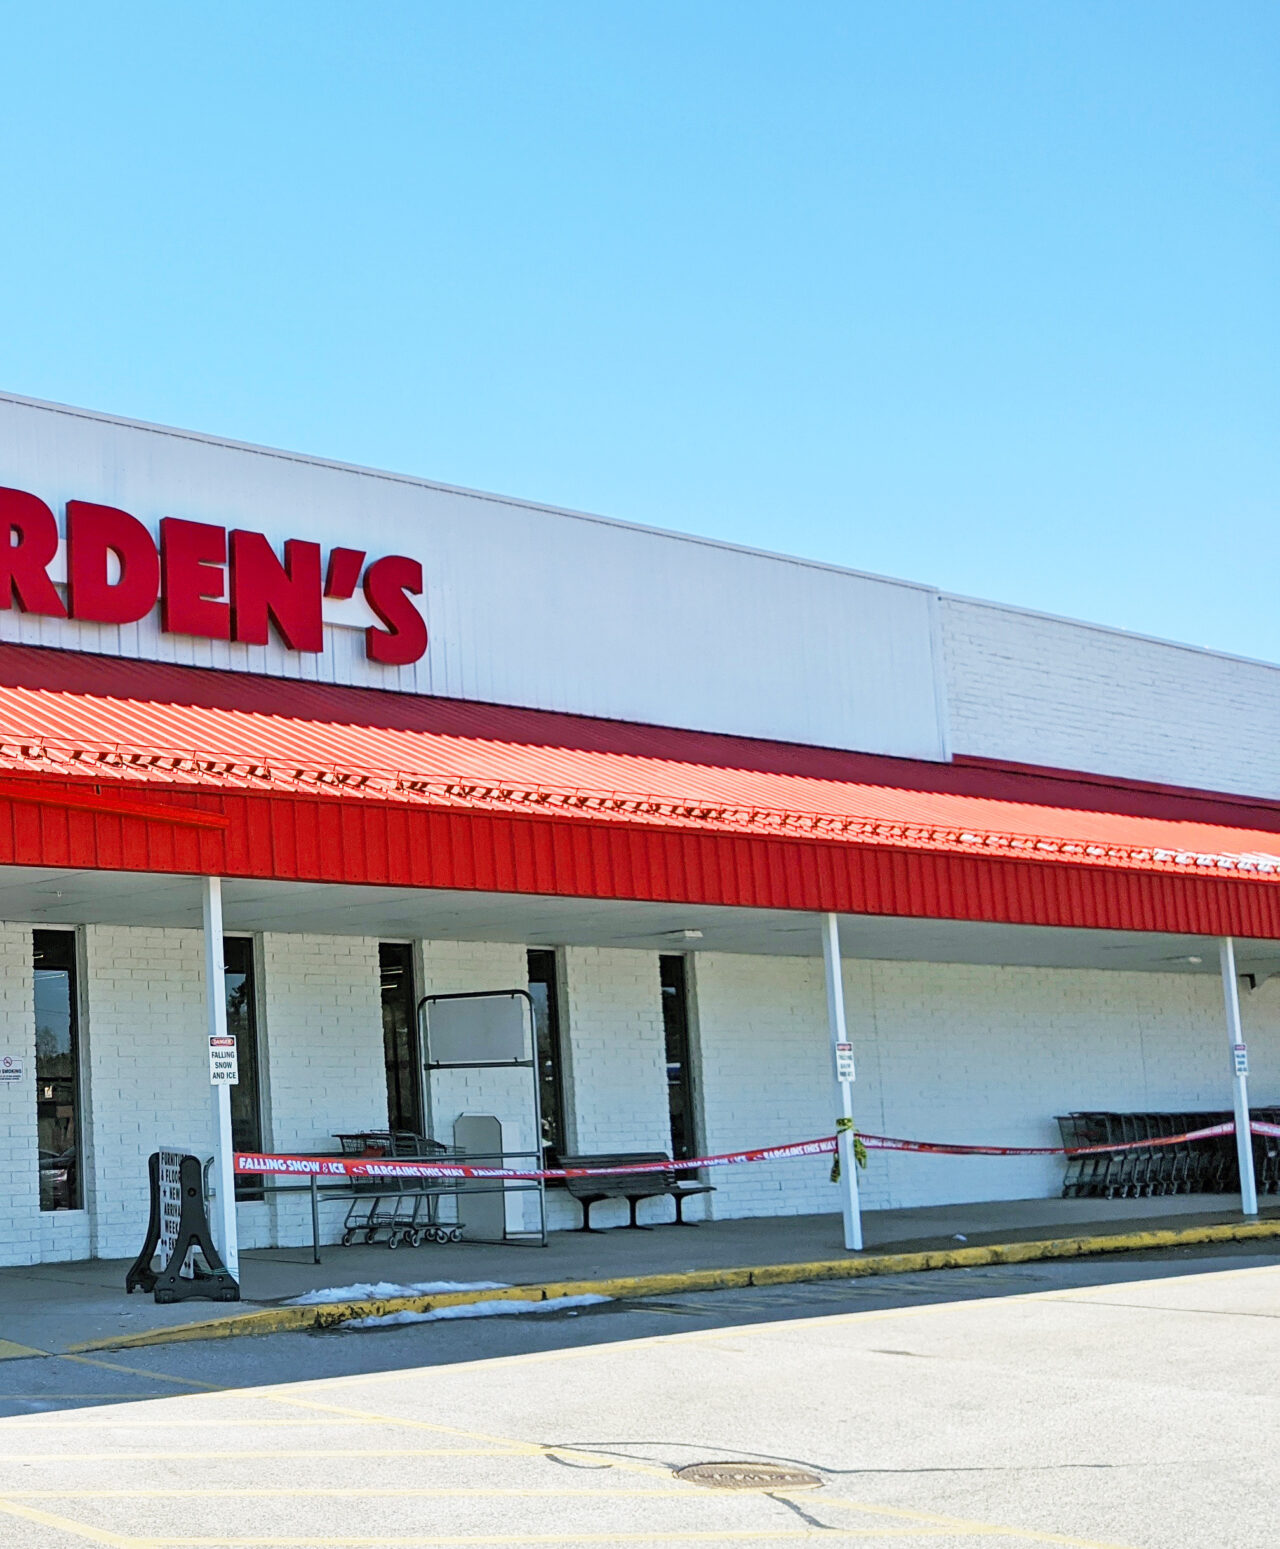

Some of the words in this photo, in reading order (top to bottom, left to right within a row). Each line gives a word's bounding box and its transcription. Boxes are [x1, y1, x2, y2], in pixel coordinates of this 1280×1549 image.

[211, 1051, 235, 1059] FALLING
[214, 1061, 233, 1069] SNOW
[226, 1071, 237, 1079] ICE
[239, 1156, 287, 1170] FALLING
[289, 1160, 320, 1173] SNOW
[328, 1162, 346, 1174] ICE
[366, 1164, 420, 1177] BARGAINS
[419, 1166, 442, 1177] THIS
[441, 1168, 465, 1177] WAY
